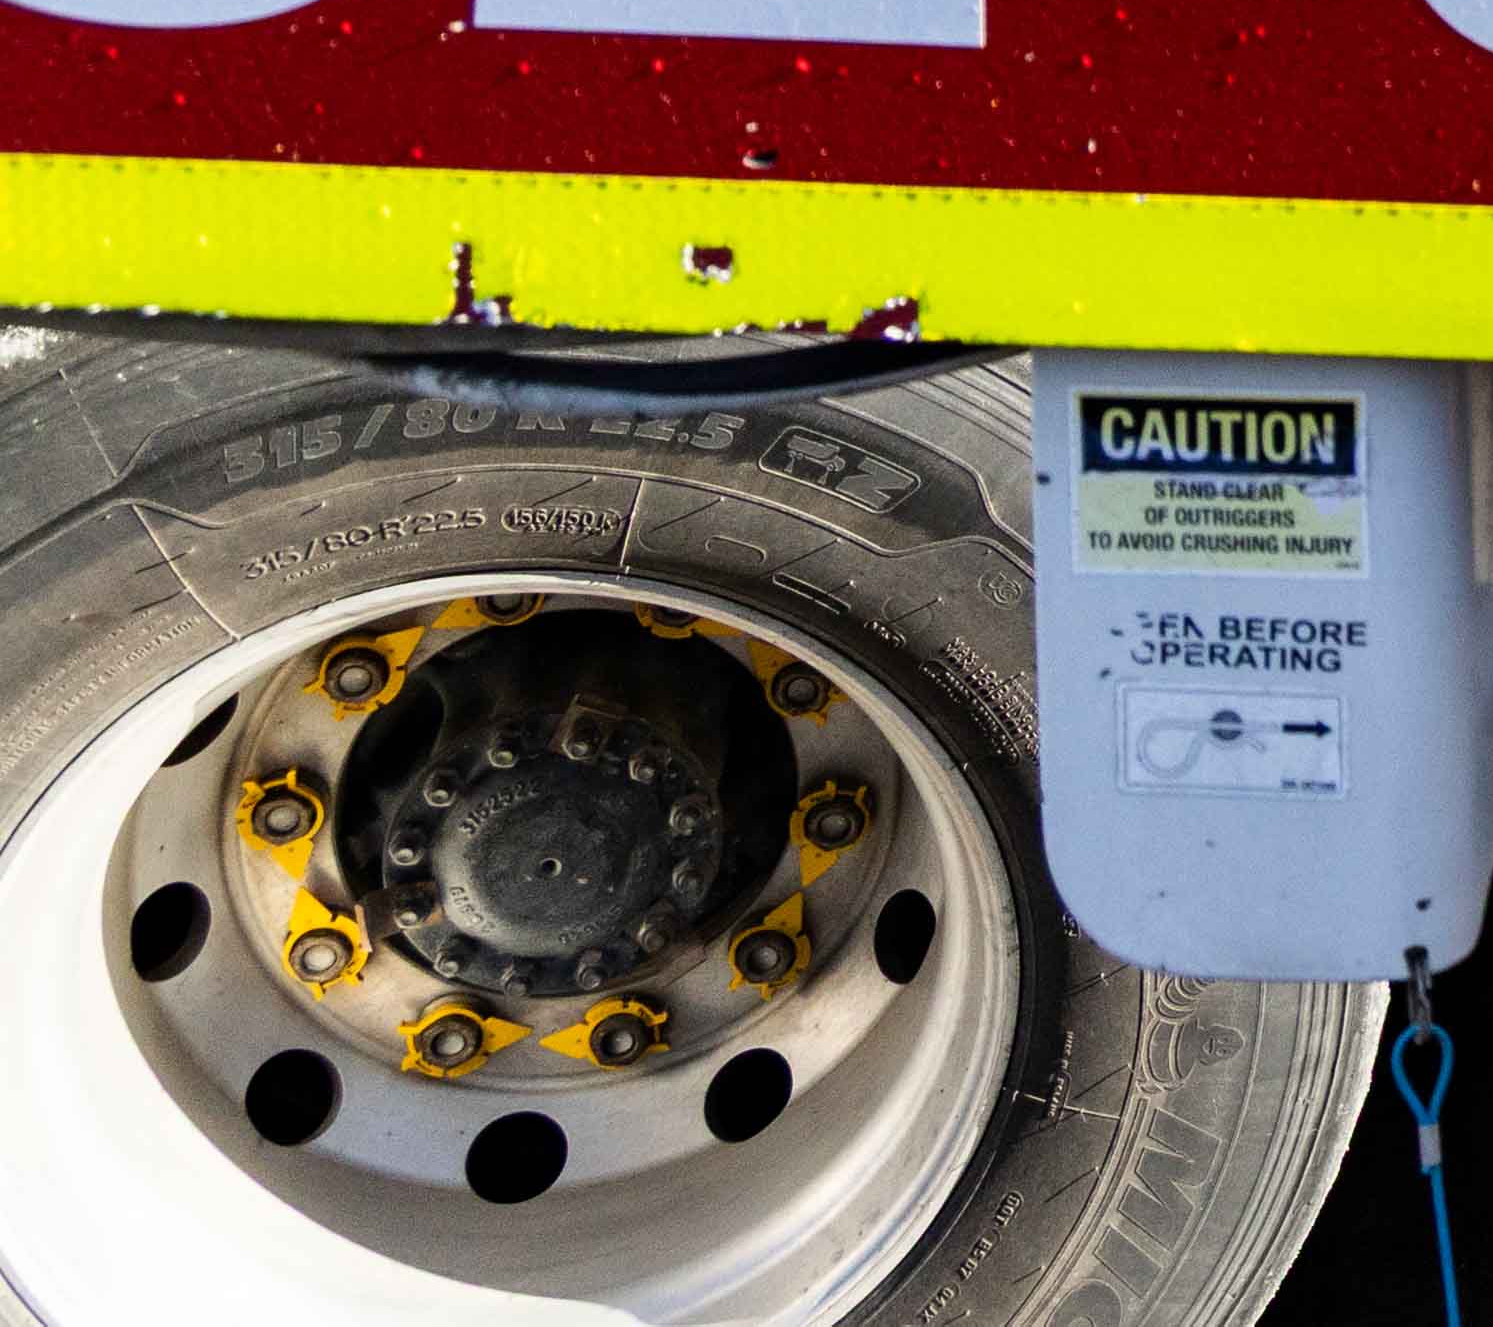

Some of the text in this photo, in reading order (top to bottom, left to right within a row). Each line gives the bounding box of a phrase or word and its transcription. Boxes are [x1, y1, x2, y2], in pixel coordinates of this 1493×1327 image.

[1100, 407, 1335, 464] CAUTION
[1154, 479, 1284, 501] STAND CLEAR
[1144, 507, 1295, 528] OF OUTRIGGERS
[1089, 532, 1353, 556] TO AVOID CRUSHING INJURY
[1218, 616, 1367, 647] BEFORE
[1131, 640, 1342, 673] OPERATING
